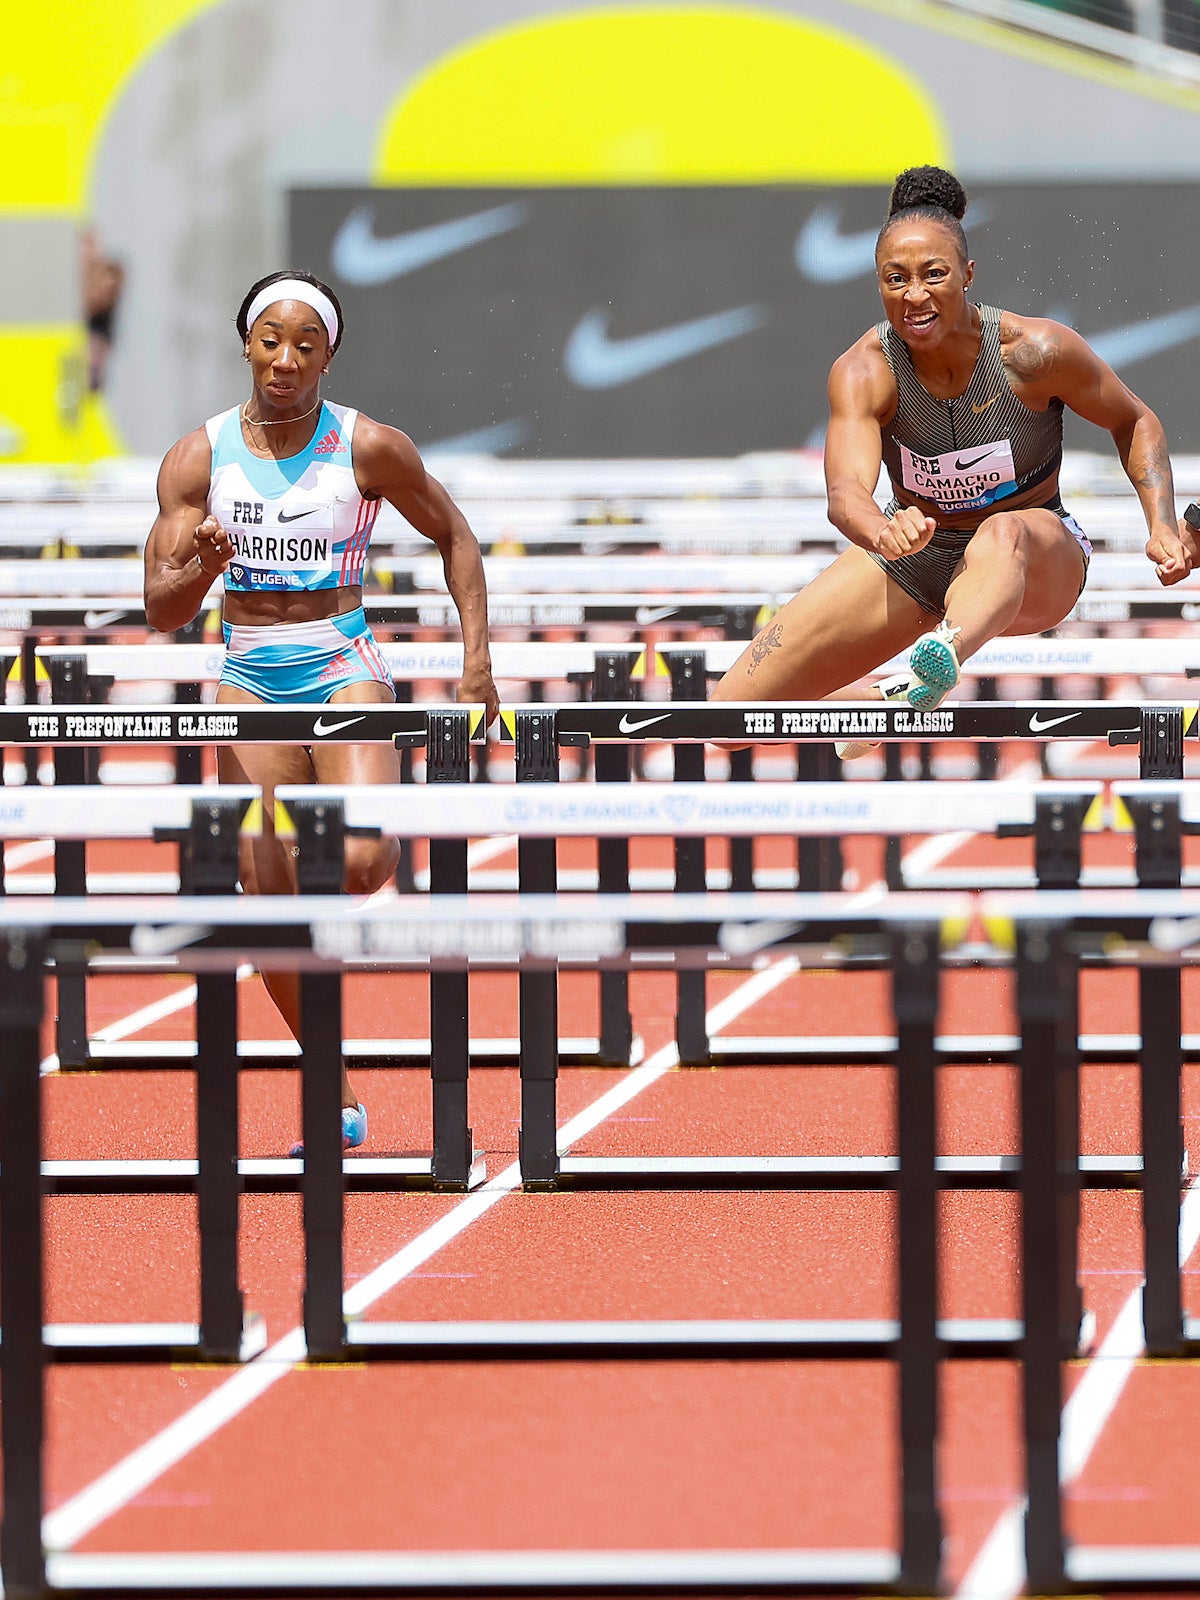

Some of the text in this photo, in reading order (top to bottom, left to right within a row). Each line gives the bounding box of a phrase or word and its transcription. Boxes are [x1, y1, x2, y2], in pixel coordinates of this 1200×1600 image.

[314, 443, 347, 454] adidas
[909, 451, 941, 475] PRE
[914, 472, 1000, 489] CAMACHO
[932, 482, 985, 500] QUINN
[938, 496, 988, 511] EUGENE
[233, 501, 264, 524] PRE
[228, 533, 327, 562] HARRISON
[250, 572, 300, 586] EUGENE
[1037, 651, 1094, 664] LEAGUE
[318, 665, 360, 682] adidas
[28, 715, 239, 737] THE PREFONTAINE CLASSIC
[744, 711, 954, 733] THE PREFONTAINE CLASSIC
